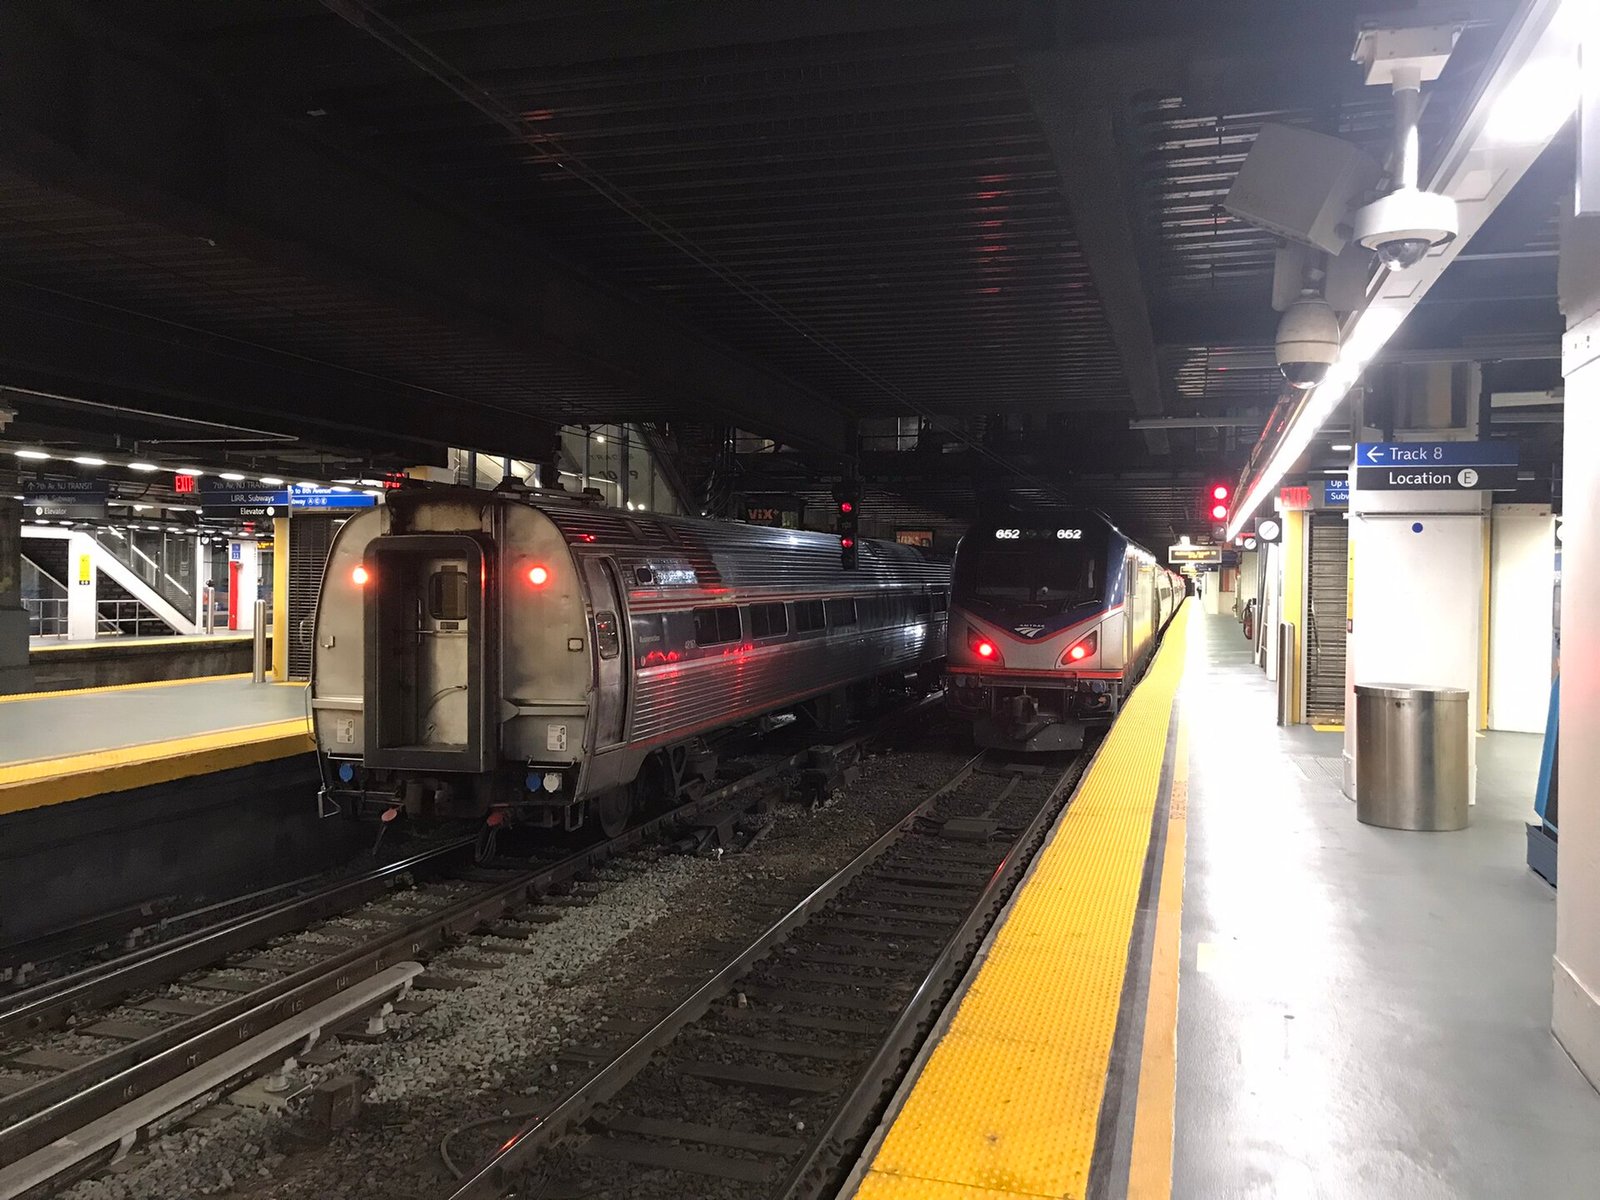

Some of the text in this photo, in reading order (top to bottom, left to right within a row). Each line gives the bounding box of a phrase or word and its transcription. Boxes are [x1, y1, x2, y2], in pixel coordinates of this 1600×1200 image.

[1389, 447, 1442, 460] Track 8
[1389, 471, 1451, 485] Location
[175, 475, 192, 492] EXIT
[1330, 480, 1343, 488] Up
[248, 494, 275, 504] Subways
[44, 507, 67, 515] Elevator
[240, 507, 265, 515] Elevator
[995, 529, 1020, 539] 652
[1056, 529, 1082, 539] 652
